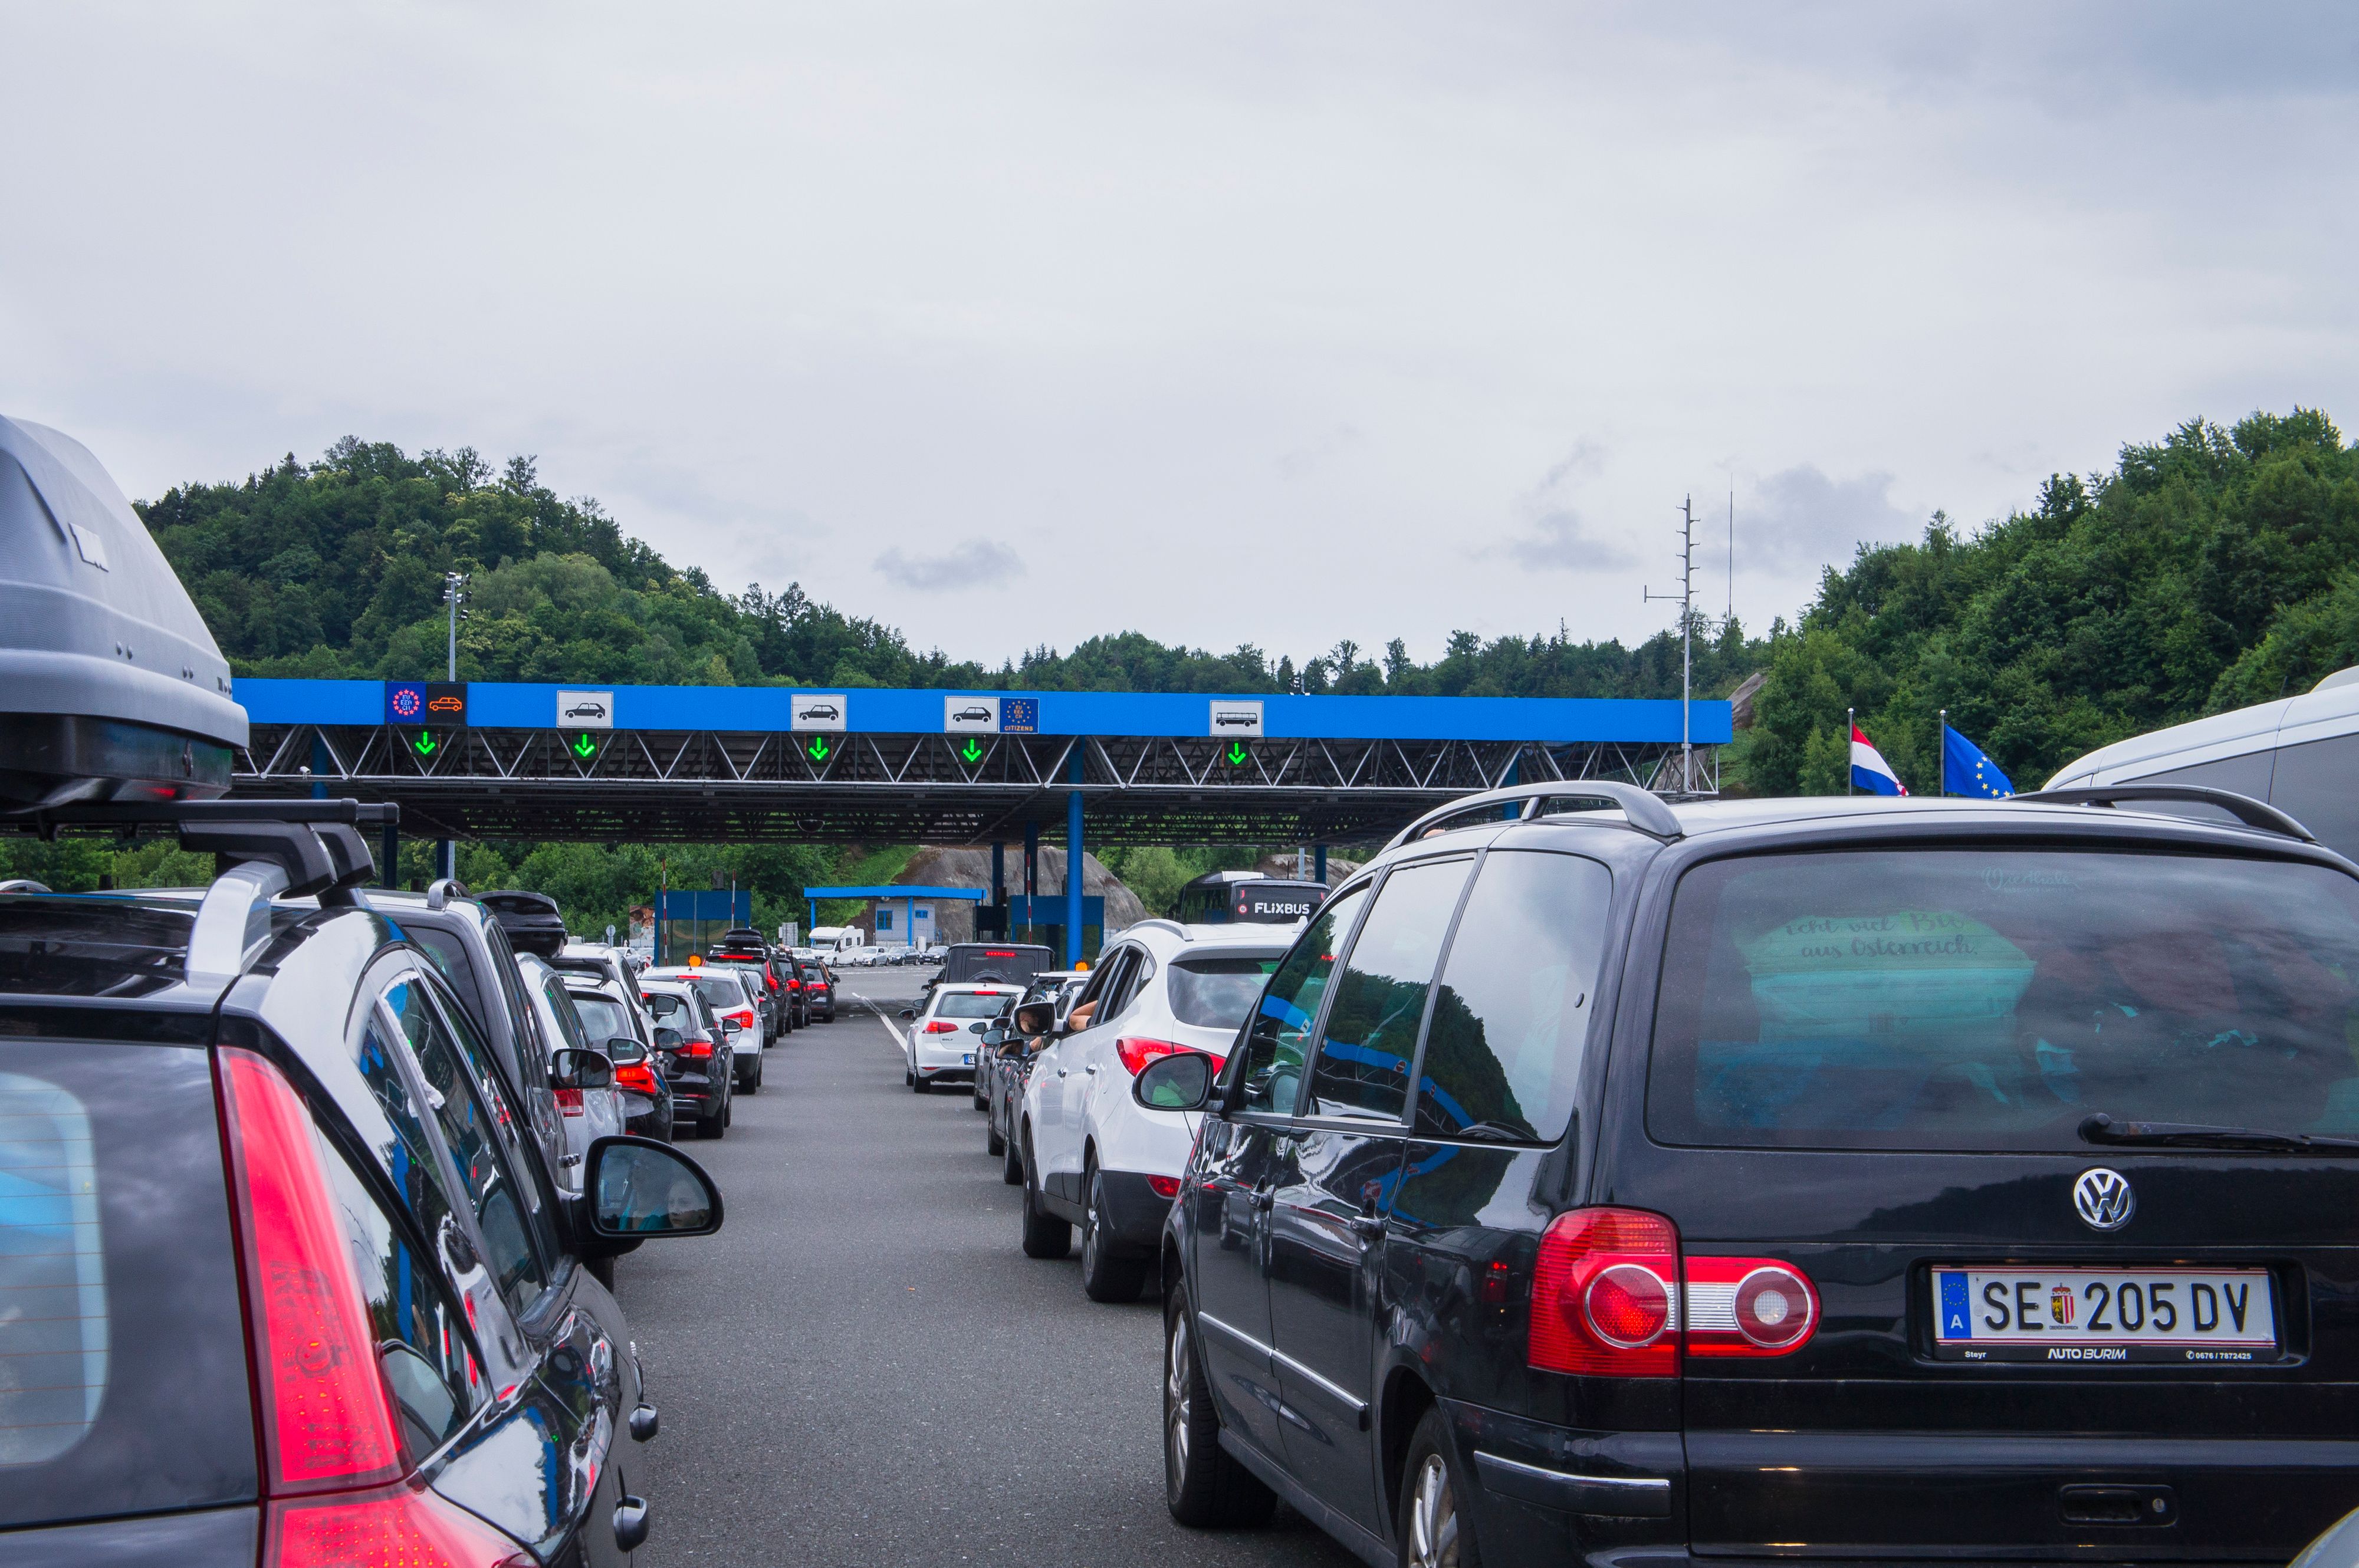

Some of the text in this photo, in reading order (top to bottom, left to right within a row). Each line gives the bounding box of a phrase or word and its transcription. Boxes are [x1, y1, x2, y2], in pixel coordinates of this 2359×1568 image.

[1848, 918, 1897, 932] viel
[1909, 912, 1964, 932] Bio
[1801, 945, 1843, 958] aus
[2074, 1168, 2133, 1228] VW
[1950, 1281, 2248, 1332] A SE 205 DV
[2048, 1348, 2082, 1359] AUTO
[2083, 1349, 2126, 1360] BURIM
